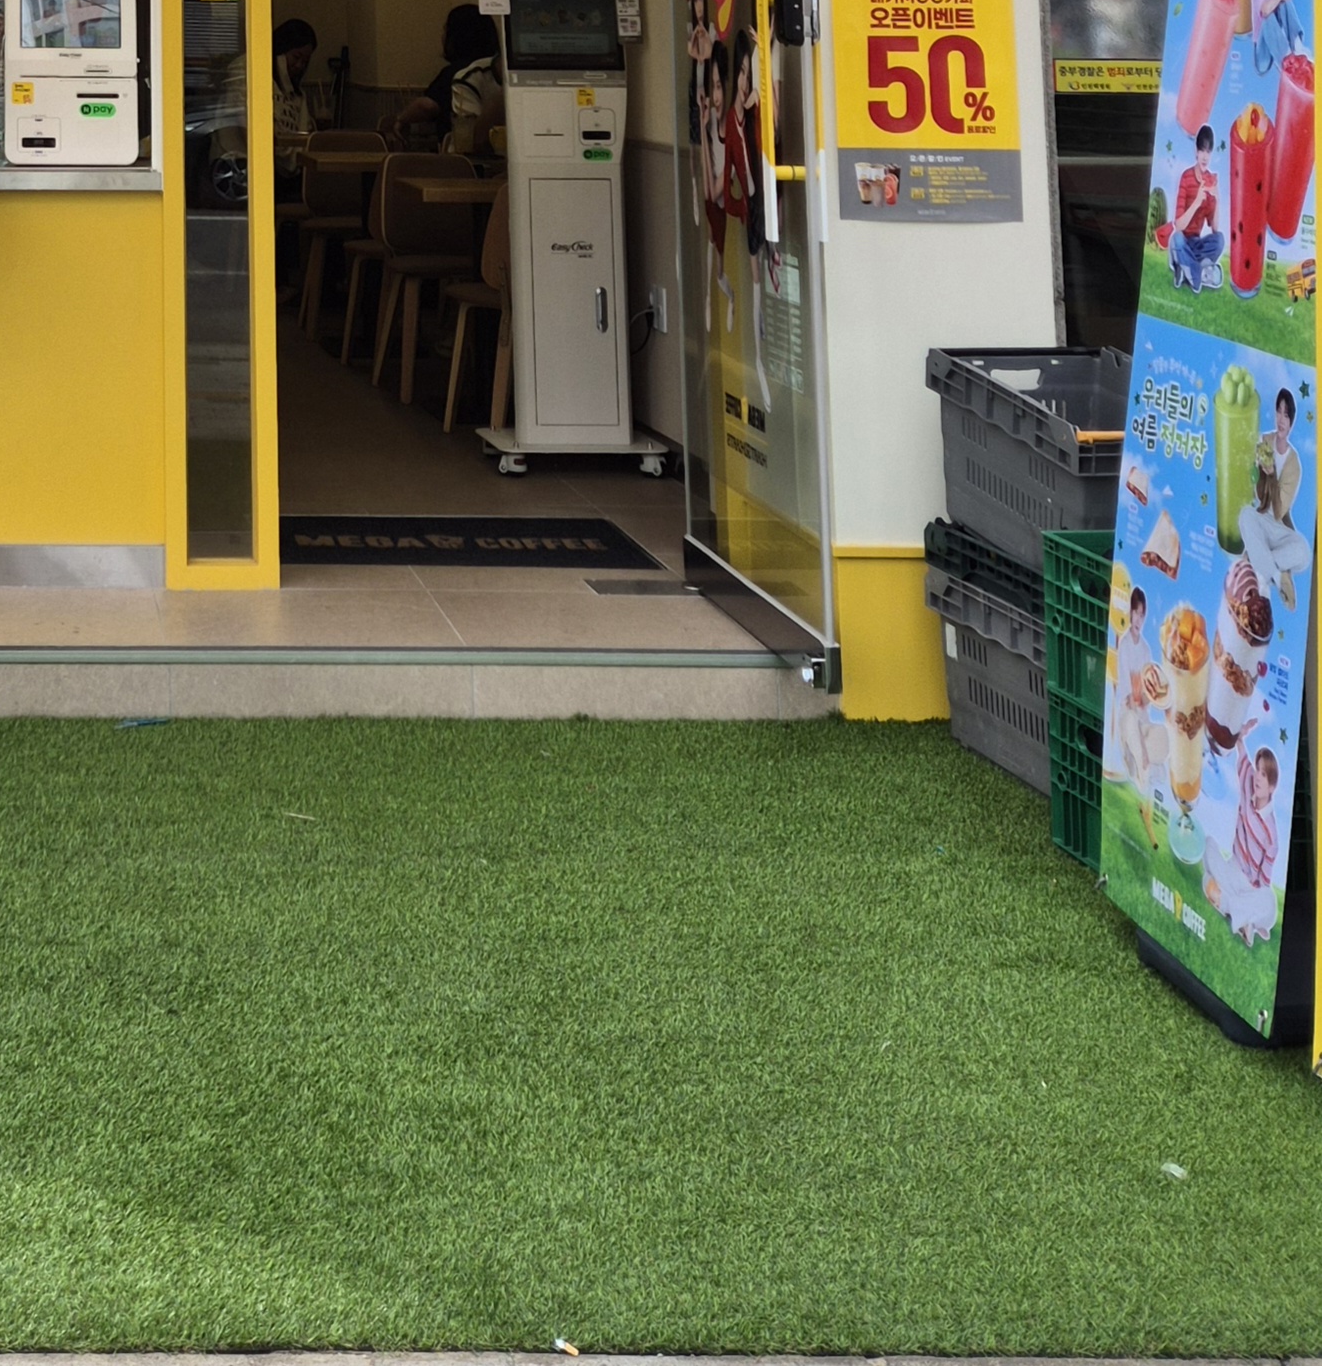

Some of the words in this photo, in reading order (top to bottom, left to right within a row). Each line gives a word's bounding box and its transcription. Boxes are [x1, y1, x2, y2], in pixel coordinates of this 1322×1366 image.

[870, 7, 976, 30] 오픈이벤트
[1106, 66, 1153, 78] 범죄로부터
[93, 104, 114, 115] pay
[1142, 378, 1195, 422] 우리들의
[1132, 414, 1158, 451] 여름
[1160, 424, 1209, 470] 정거장
[293, 534, 428, 548] MEGA
[474, 535, 609, 551] COFFEE
